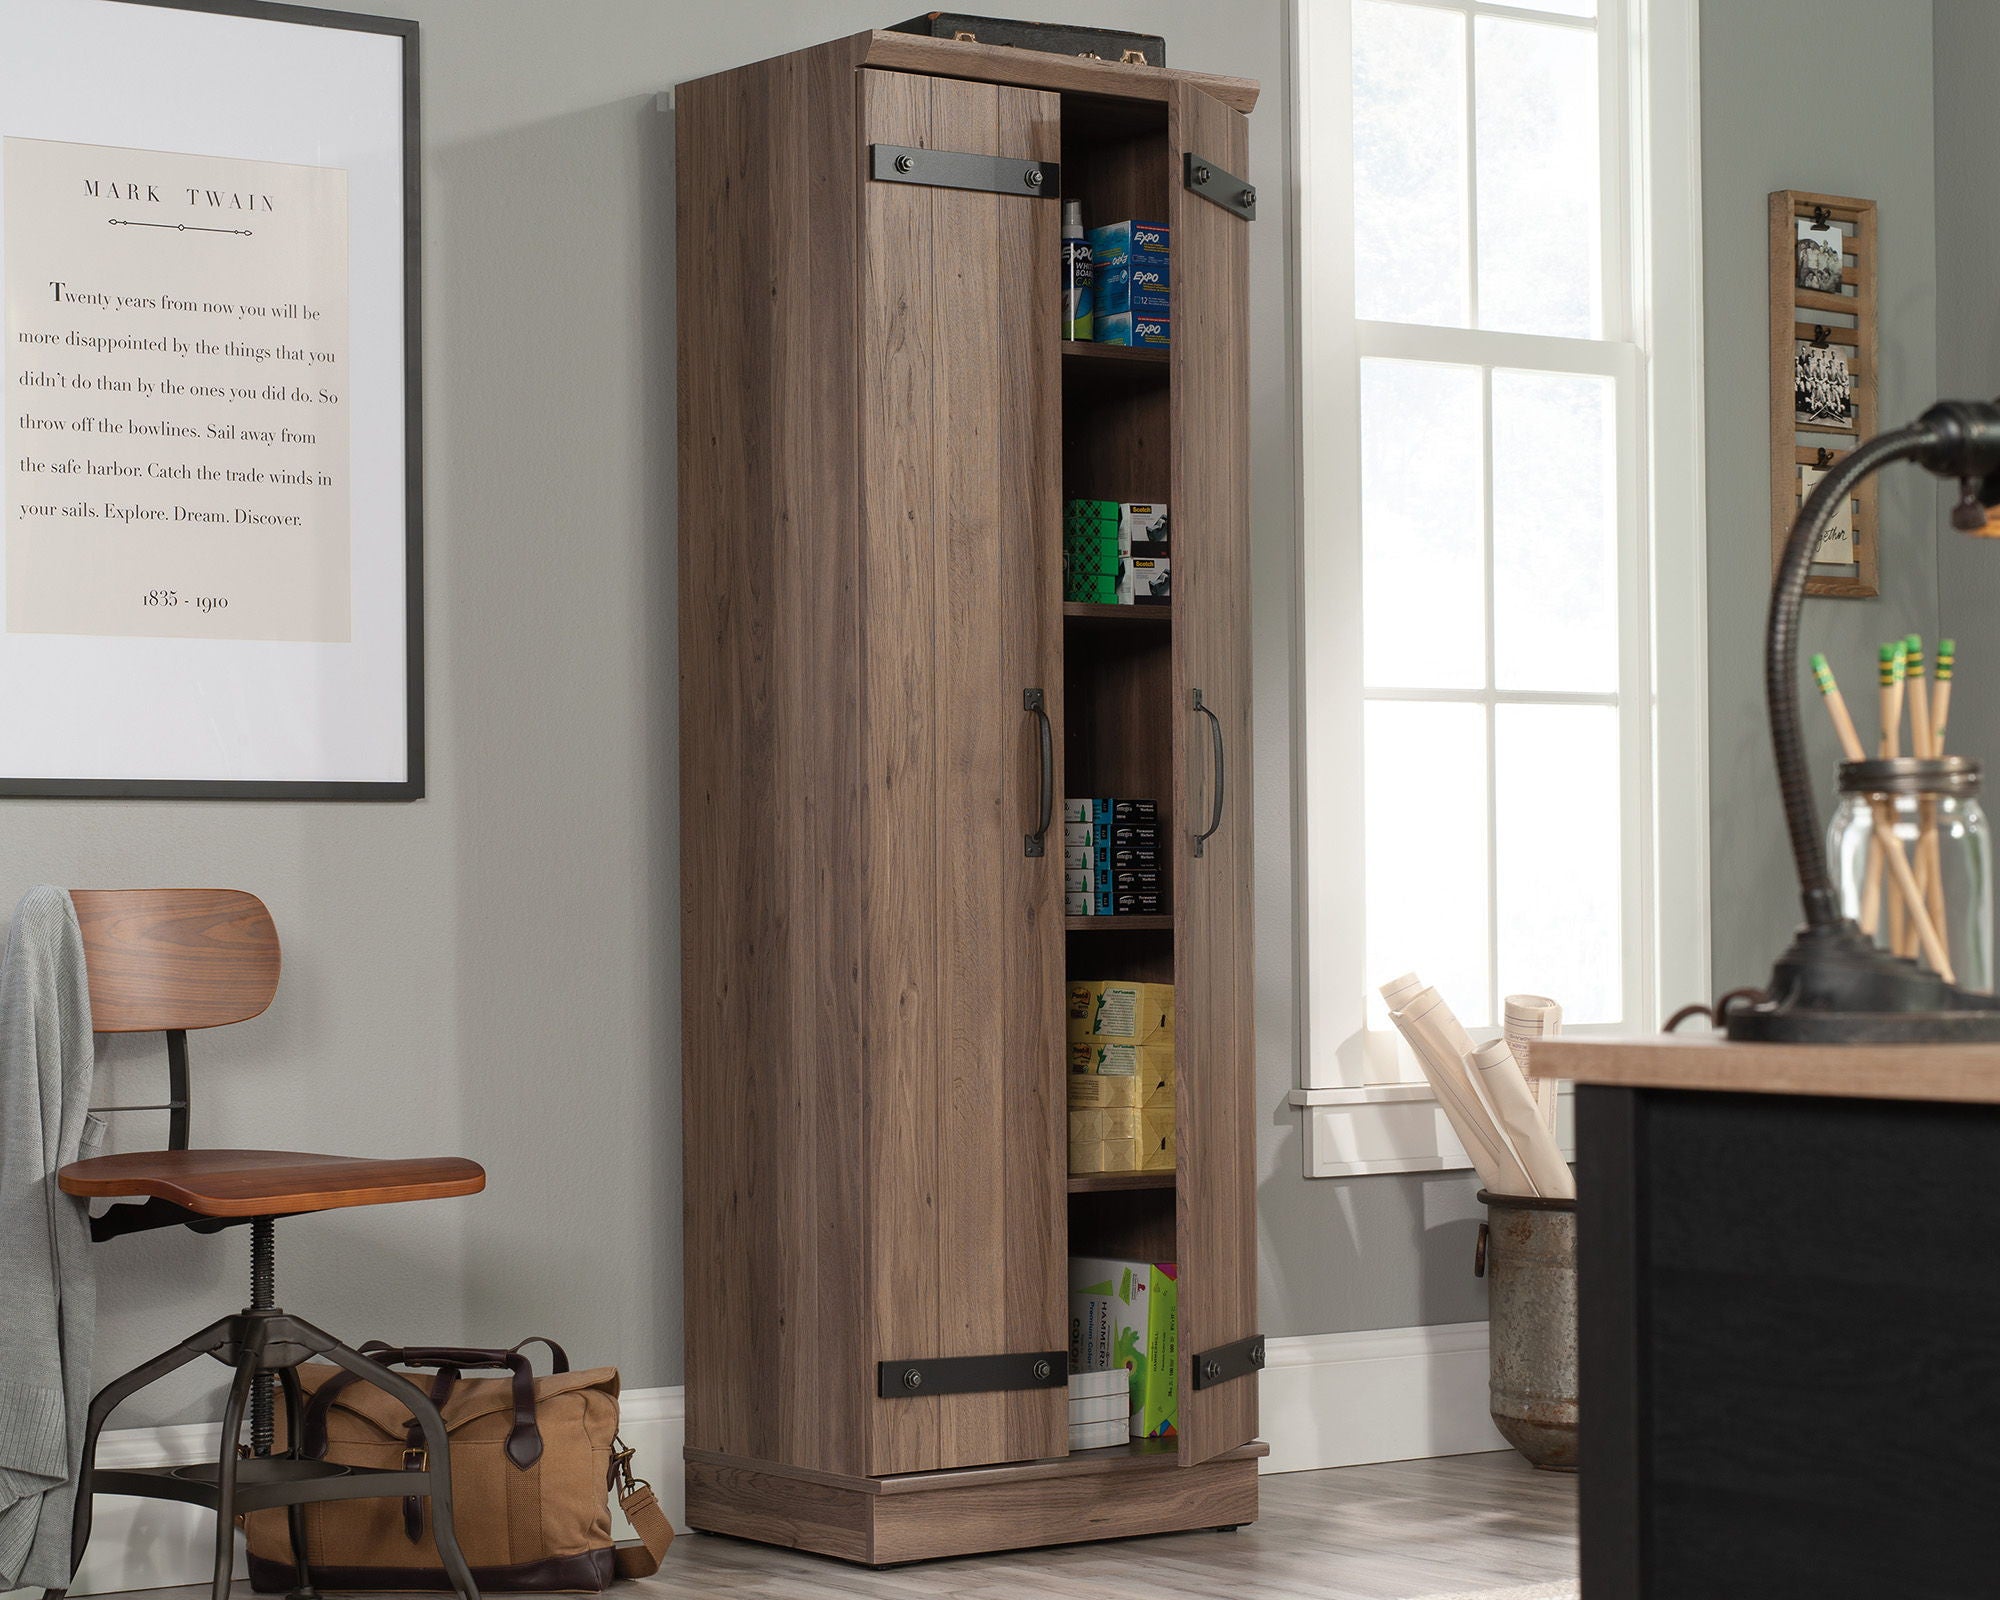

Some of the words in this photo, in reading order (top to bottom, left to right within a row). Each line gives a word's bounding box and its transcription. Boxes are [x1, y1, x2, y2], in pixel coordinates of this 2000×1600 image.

[84, 179, 161, 202] MARK
[187, 188, 274, 213] TWAIN
[1134, 232, 1159, 245] EXPO
[1133, 271, 1159, 285] EXPO
[49, 281, 112, 310] Twenty
[116, 295, 157, 311] years
[162, 294, 198, 311] from
[203, 302, 235, 313] now
[239, 305, 266, 320] you
[272, 303, 297, 318] will
[304, 304, 321, 320] be
[1141, 297, 1148, 305] 12
[1135, 323, 1161, 337] EXPO
[19, 331, 60, 345] more
[66, 330, 167, 353] disappointed
[174, 337, 190, 358] by
[196, 338, 220, 354] the
[225, 340, 272, 363] things
[277, 344, 306, 360] that
[309, 351, 335, 366] you
[19, 370, 66, 388] didn’t
[72, 373, 92, 391] do
[97, 375, 132, 391] than
[138, 376, 156, 396] by
[161, 378, 185, 395] the
[190, 385, 226, 397] ones
[229, 388, 257, 402] you
[262, 384, 286, 400] did
[291, 386, 313, 402] do.
[319, 388, 339, 404] So
[20, 413, 67, 431] throw
[72, 416, 96, 431] off
[99, 417, 124, 433] the
[129, 418, 201, 437] bowlines.
[207, 423, 235, 439] Sail
[241, 430, 277, 447] away
[282, 427, 316, 444] from
[21, 456, 46, 472] the
[51, 458, 82, 474] safe
[88, 459, 143, 477] harbor.
[148, 462, 192, 479] Catch
[197, 464, 221, 480] the
[227, 467, 265, 483] trade
[270, 469, 314, 485] winds
[319, 471, 332, 486] in
[20, 504, 58, 520] your
[62, 501, 99, 519] sails.
[104, 502, 169, 524] Explore.
[174, 505, 230, 523] Dream.
[235, 507, 302, 526] Discover.
[144, 588, 178, 606] 1835
[197, 595, 229, 613] 1910
[1099, 1301, 1107, 1367] HAMMERM
